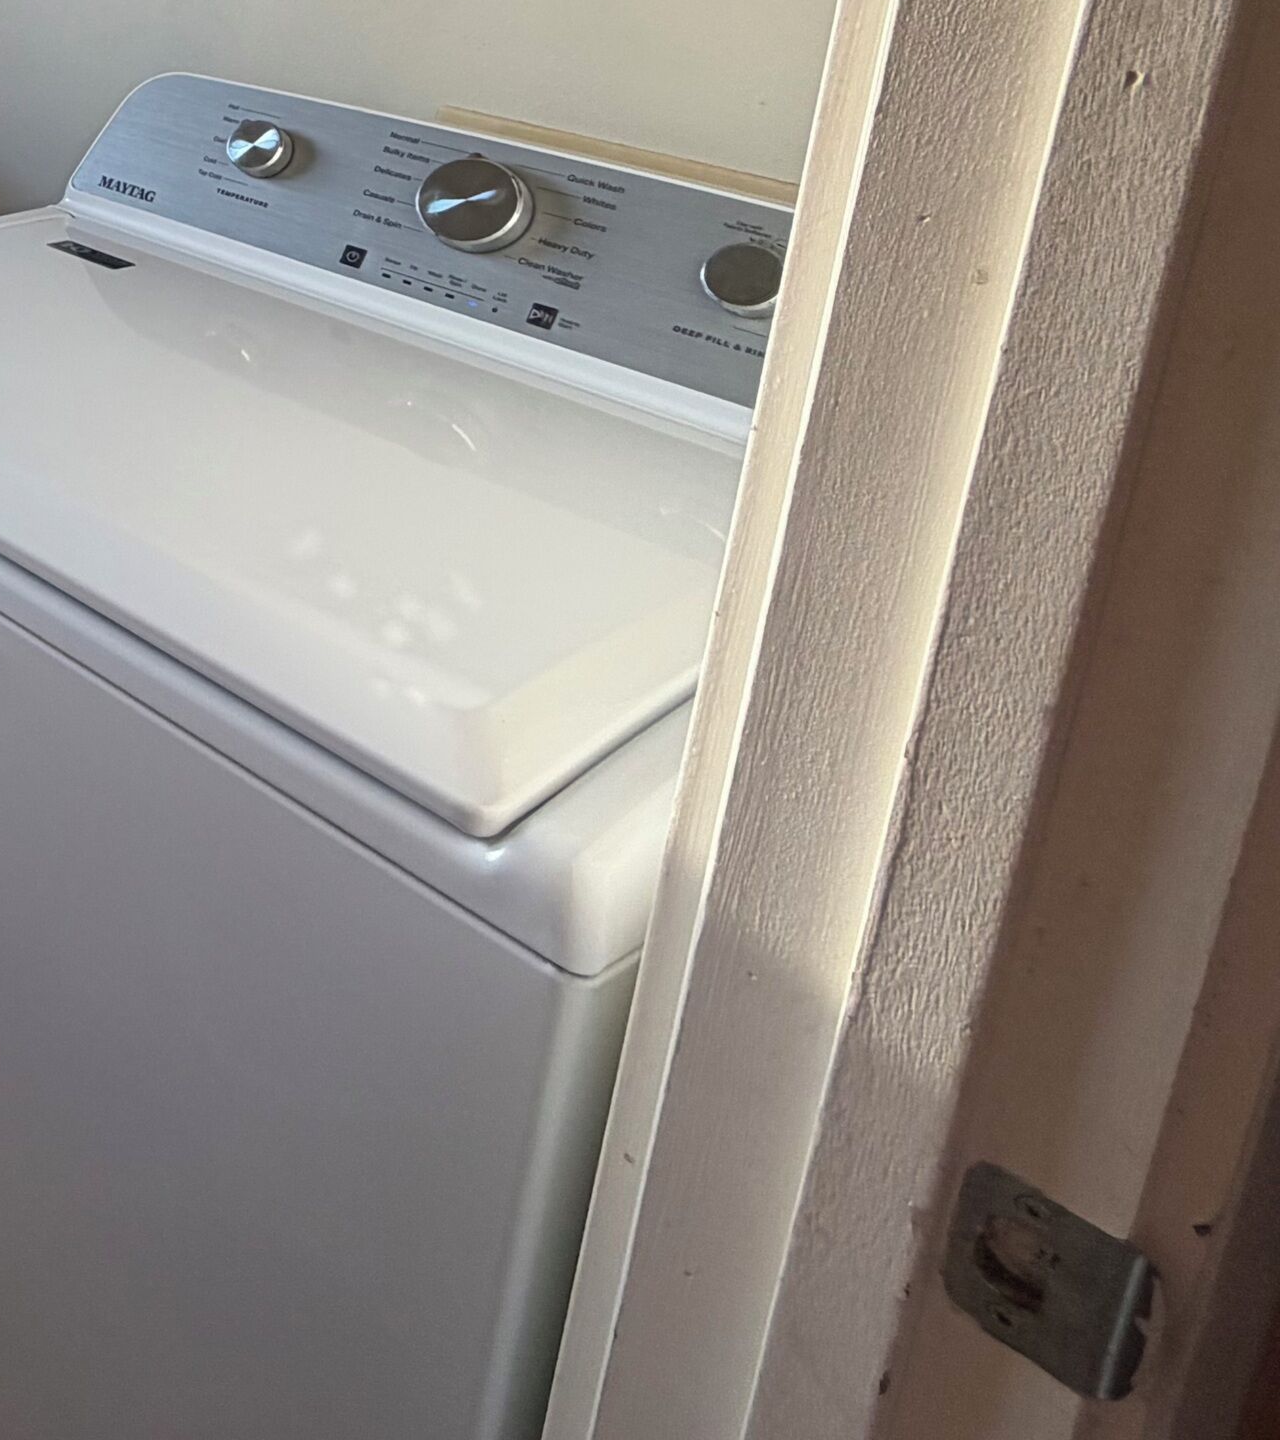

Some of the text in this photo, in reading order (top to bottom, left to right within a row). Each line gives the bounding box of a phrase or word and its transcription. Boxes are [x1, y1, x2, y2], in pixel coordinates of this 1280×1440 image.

[97, 174, 156, 203] MAYTAG
[566, 173, 594, 186] Quick
[216, 187, 269, 208] TEMPERATURE
[352, 208, 374, 220] Drain
[382, 217, 402, 229] Spin
[538, 237, 595, 259] Heavy Duty
[518, 256, 545, 270] Clean
[672, 324, 703, 339] DEEP
[705, 335, 730, 348] FILL
